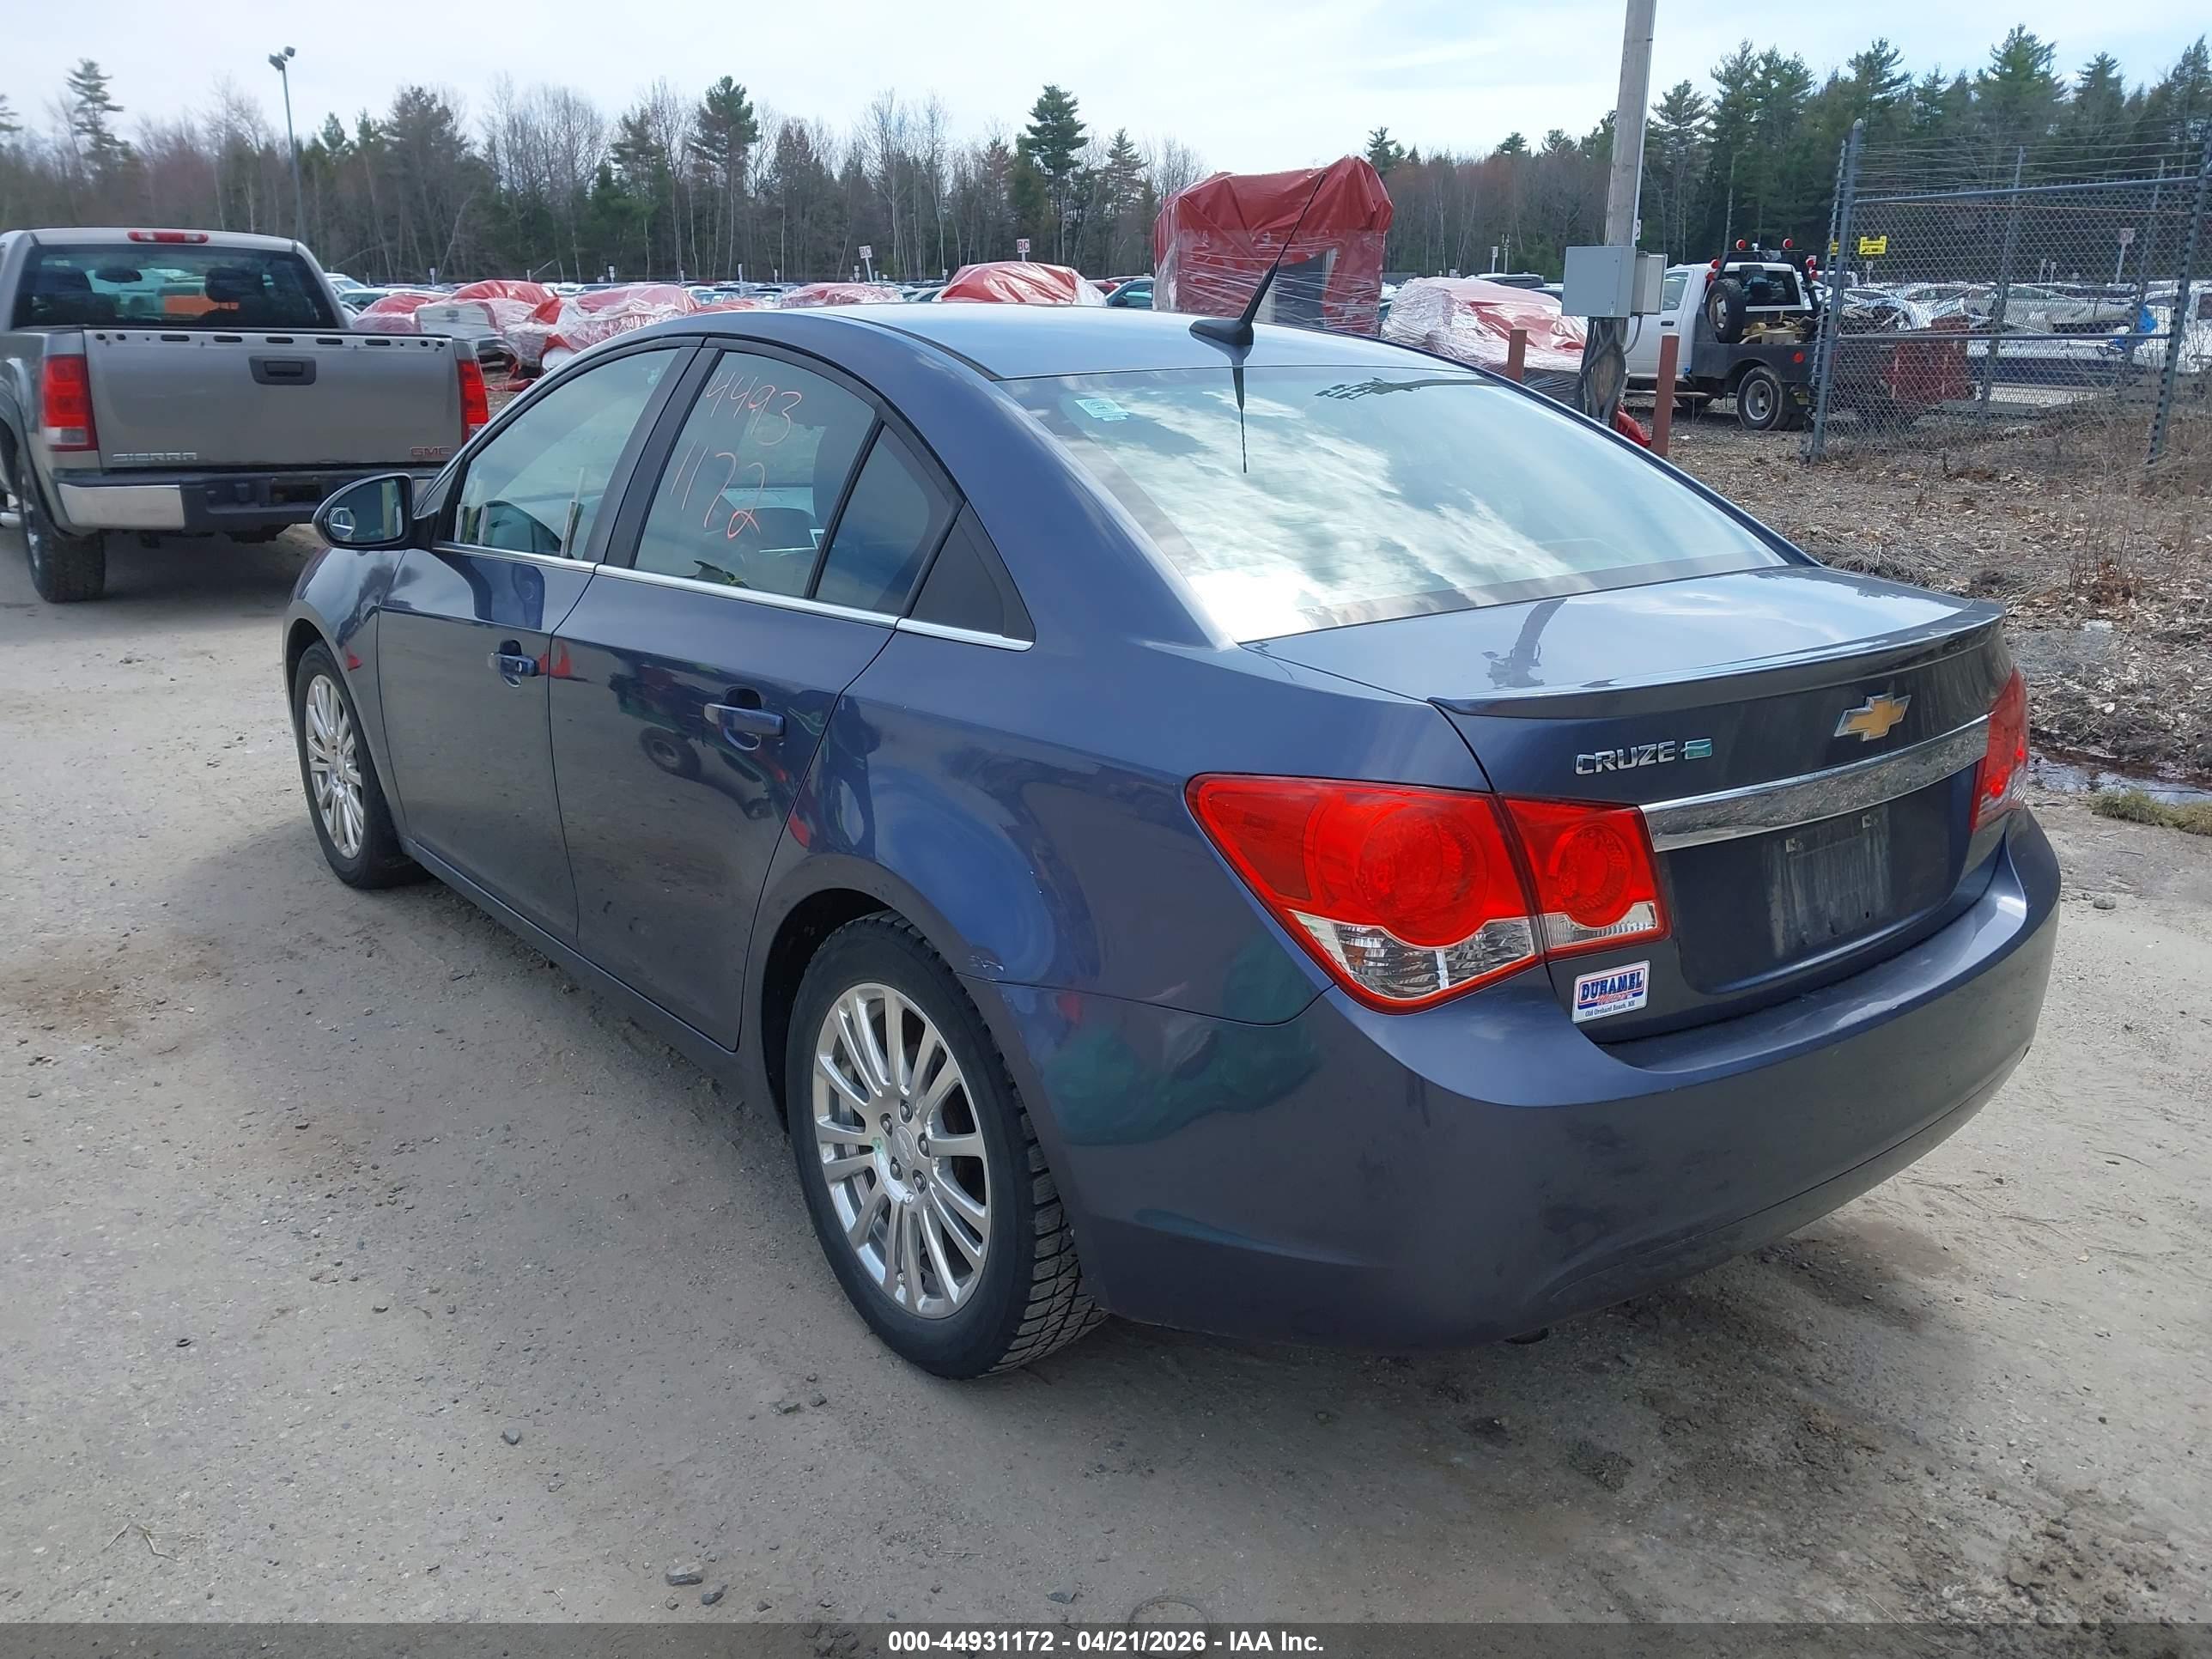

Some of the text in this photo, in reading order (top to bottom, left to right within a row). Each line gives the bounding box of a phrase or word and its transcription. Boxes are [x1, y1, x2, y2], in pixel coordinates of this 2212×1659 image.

[860, 246, 871, 257] BC
[1018, 240, 1029, 251] BC
[706, 371, 803, 446] 4493
[112, 452, 197, 462] SIERRA
[410, 446, 454, 455] GMC
[670, 439, 766, 541] 1172
[1575, 739, 1676, 775] CRUZE
[1580, 971, 1644, 1001] DUHAMEL
